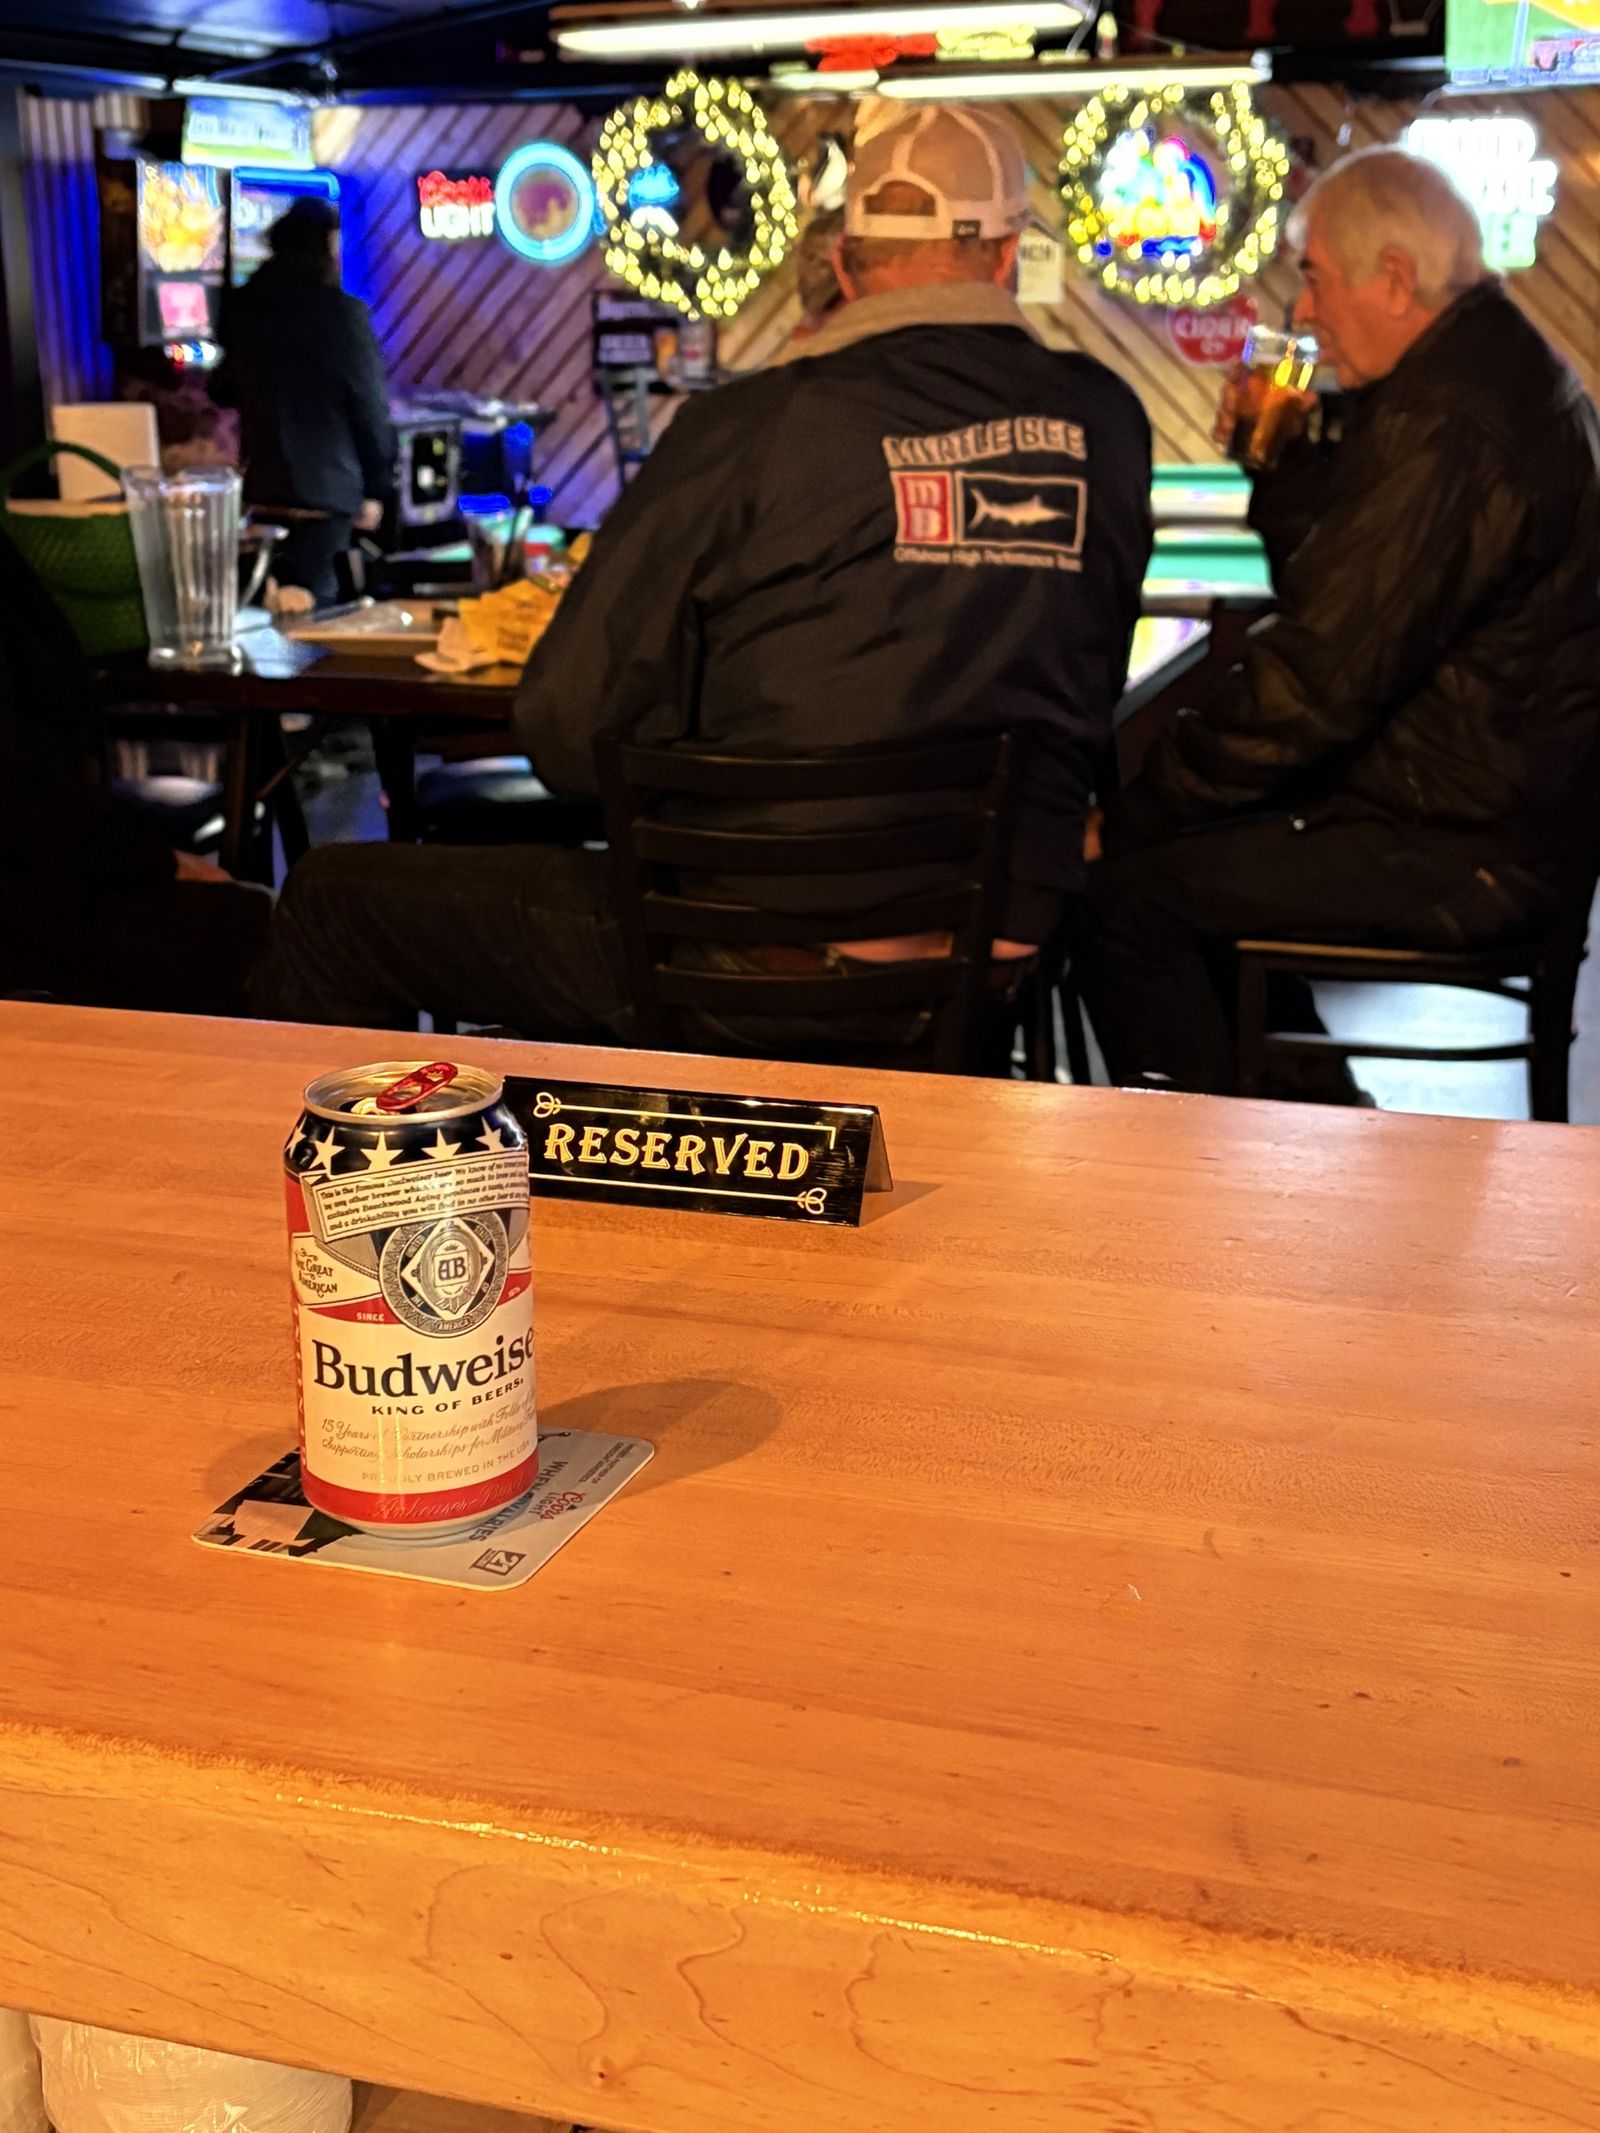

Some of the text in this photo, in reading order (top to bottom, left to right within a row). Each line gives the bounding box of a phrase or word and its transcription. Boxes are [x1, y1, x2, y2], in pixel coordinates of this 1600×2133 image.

[543, 1124, 810, 1181] RESERVED
[356, 1312, 385, 1321] SINCE
[371, 1405, 425, 1415] KING
[435, 1400, 462, 1412] OF
[321, 1418, 335, 1433] 15
[393, 1441, 466, 1460] holarships
[427, 1463, 480, 1481] BREWED
[482, 1459, 494, 1471] IN
[497, 1449, 515, 1464] THE
[528, 1492, 560, 1515] LIGHT
[540, 1491, 585, 1520] Coors
[487, 1550, 519, 1575] 21
